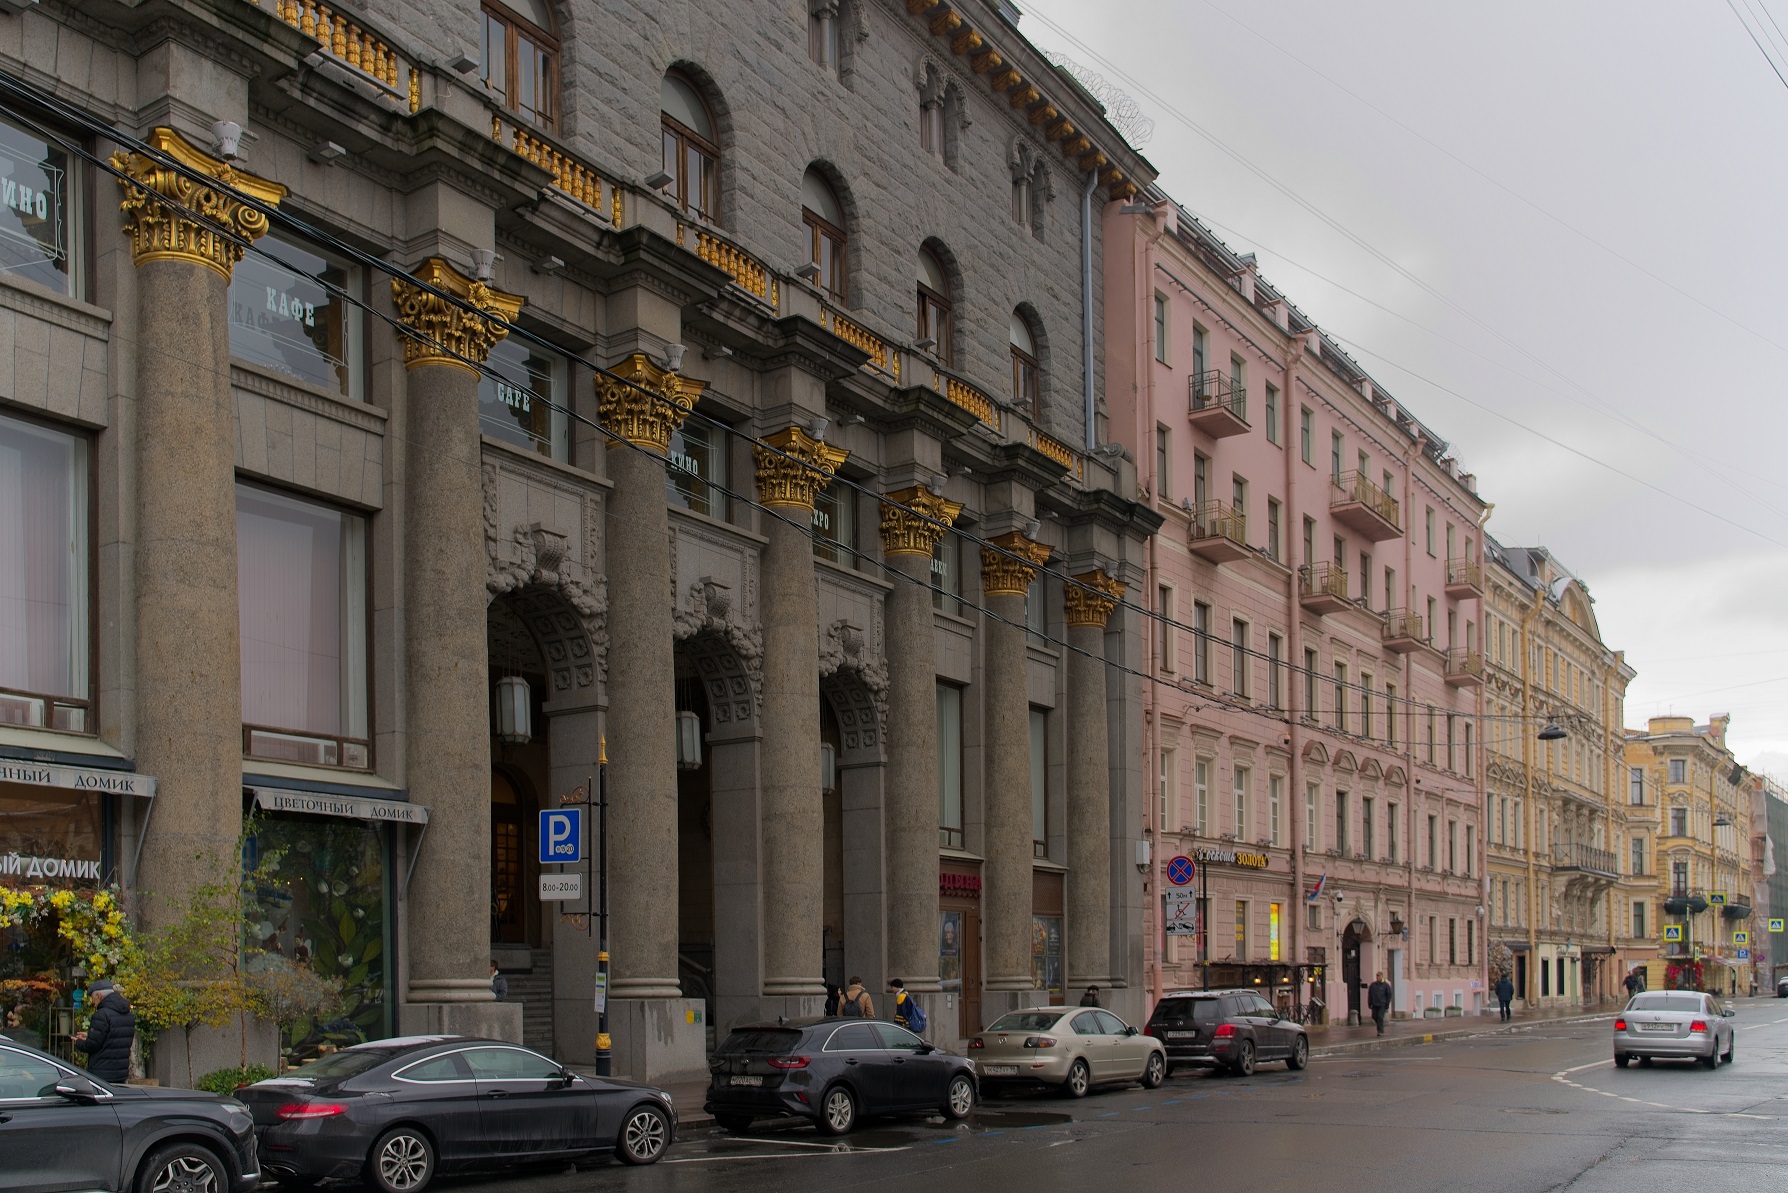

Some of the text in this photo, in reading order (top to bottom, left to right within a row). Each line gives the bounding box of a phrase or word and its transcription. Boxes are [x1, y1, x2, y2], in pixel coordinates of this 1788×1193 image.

[266, 286, 315, 327] КАФЕ
[497, 382, 530, 413] CAFE
[670, 450, 698, 476] КИНО
[810, 508, 829, 530] XPO
[75, 775, 135, 792] ДОМИК
[273, 796, 413, 820] ЦВЕТОЧНЫЙ ДОМИК
[549, 815, 571, 856] P
[27, 856, 100, 879] ДОМИК
[1236, 853, 1266, 867] ЗОЛОТА
